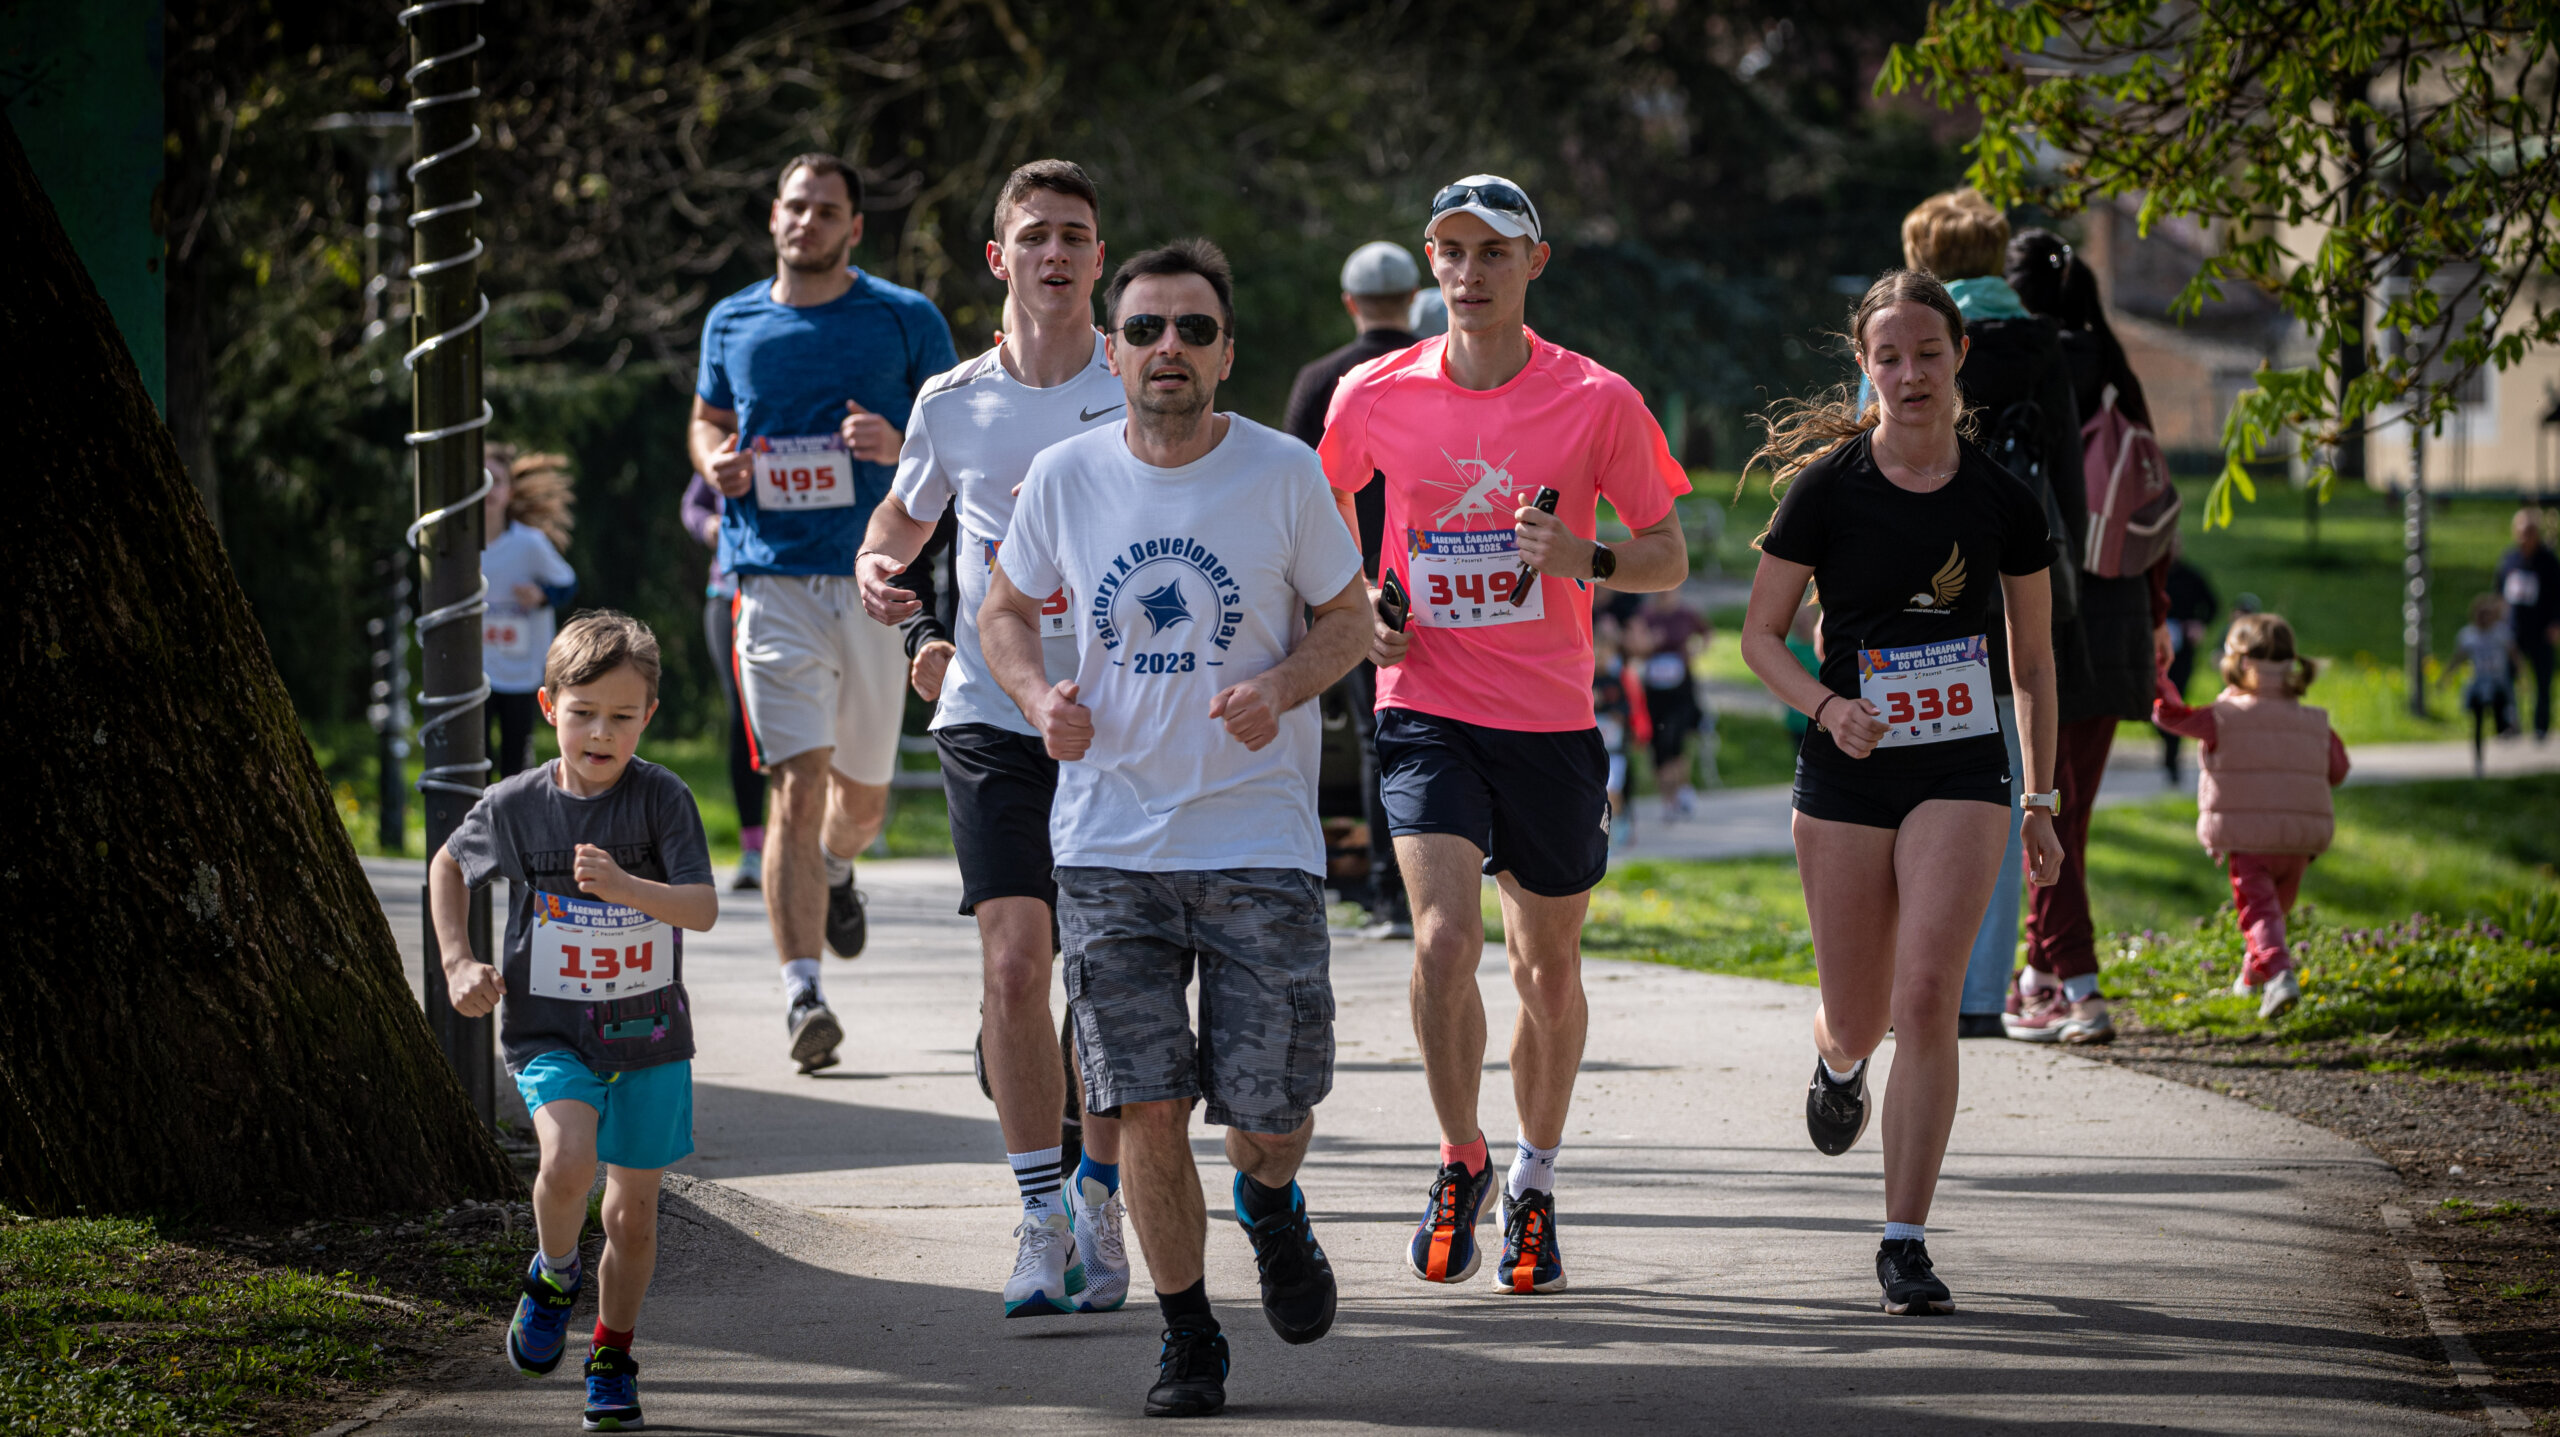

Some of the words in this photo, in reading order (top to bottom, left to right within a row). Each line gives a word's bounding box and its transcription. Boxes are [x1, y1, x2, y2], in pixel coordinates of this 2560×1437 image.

[769, 466, 836, 492] 495
[1431, 533, 1462, 545] ŠARENIM
[1464, 532, 1512, 544] ČARAPAMA
[1438, 544, 1449, 554] DO
[1452, 544, 1475, 554] CILJA
[1479, 543, 1503, 553] 2025.
[1092, 572, 1120, 651] Factory
[1112, 554, 1132, 576] X
[1129, 537, 1241, 607] Developer's
[1214, 611, 1244, 651] Day
[1428, 571, 1517, 606] 349
[1889, 651, 1923, 662] ŠARENIM
[1925, 642, 1966, 657] ČARAPAMA
[1134, 652, 1196, 674] 2023
[1897, 661, 1910, 670] DO
[1913, 658, 1936, 669] CILJA
[1938, 653, 1959, 665] 2025.
[1886, 683, 1973, 724] 338
[567, 902, 604, 917] ŠARENIM
[574, 916, 587, 925] DO
[591, 917, 618, 927] CILJA
[621, 914, 646, 925] 2025.
[560, 941, 653, 979] 134
[549, 1296, 571, 1305] FILA
[591, 1361, 613, 1371] FILA
